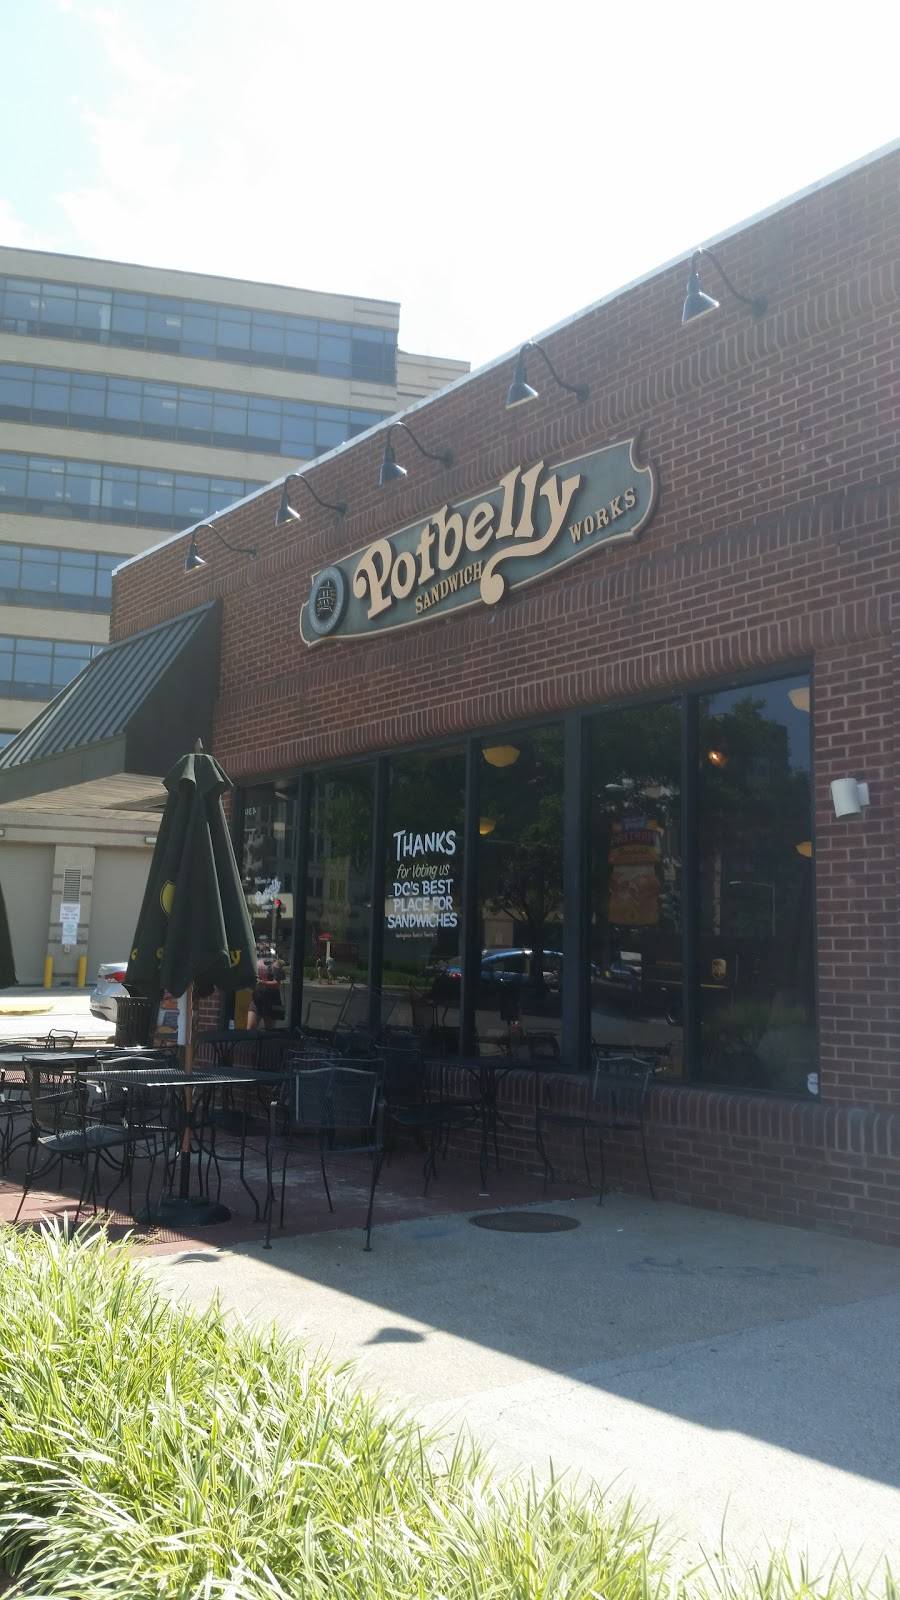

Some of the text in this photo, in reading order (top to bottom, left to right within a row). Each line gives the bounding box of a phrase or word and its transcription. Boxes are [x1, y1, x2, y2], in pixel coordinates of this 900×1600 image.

[353, 460, 581, 619] Potbelly
[414, 486, 636, 614] SANDWICH WORKS
[393, 830, 456, 861] THANKS
[397, 864, 411, 879] for
[439, 864, 450, 876] us
[422, 879, 453, 895] BEST
[393, 896, 453, 912] PLACE FOR
[387, 912, 458, 929] SANDWICHES
